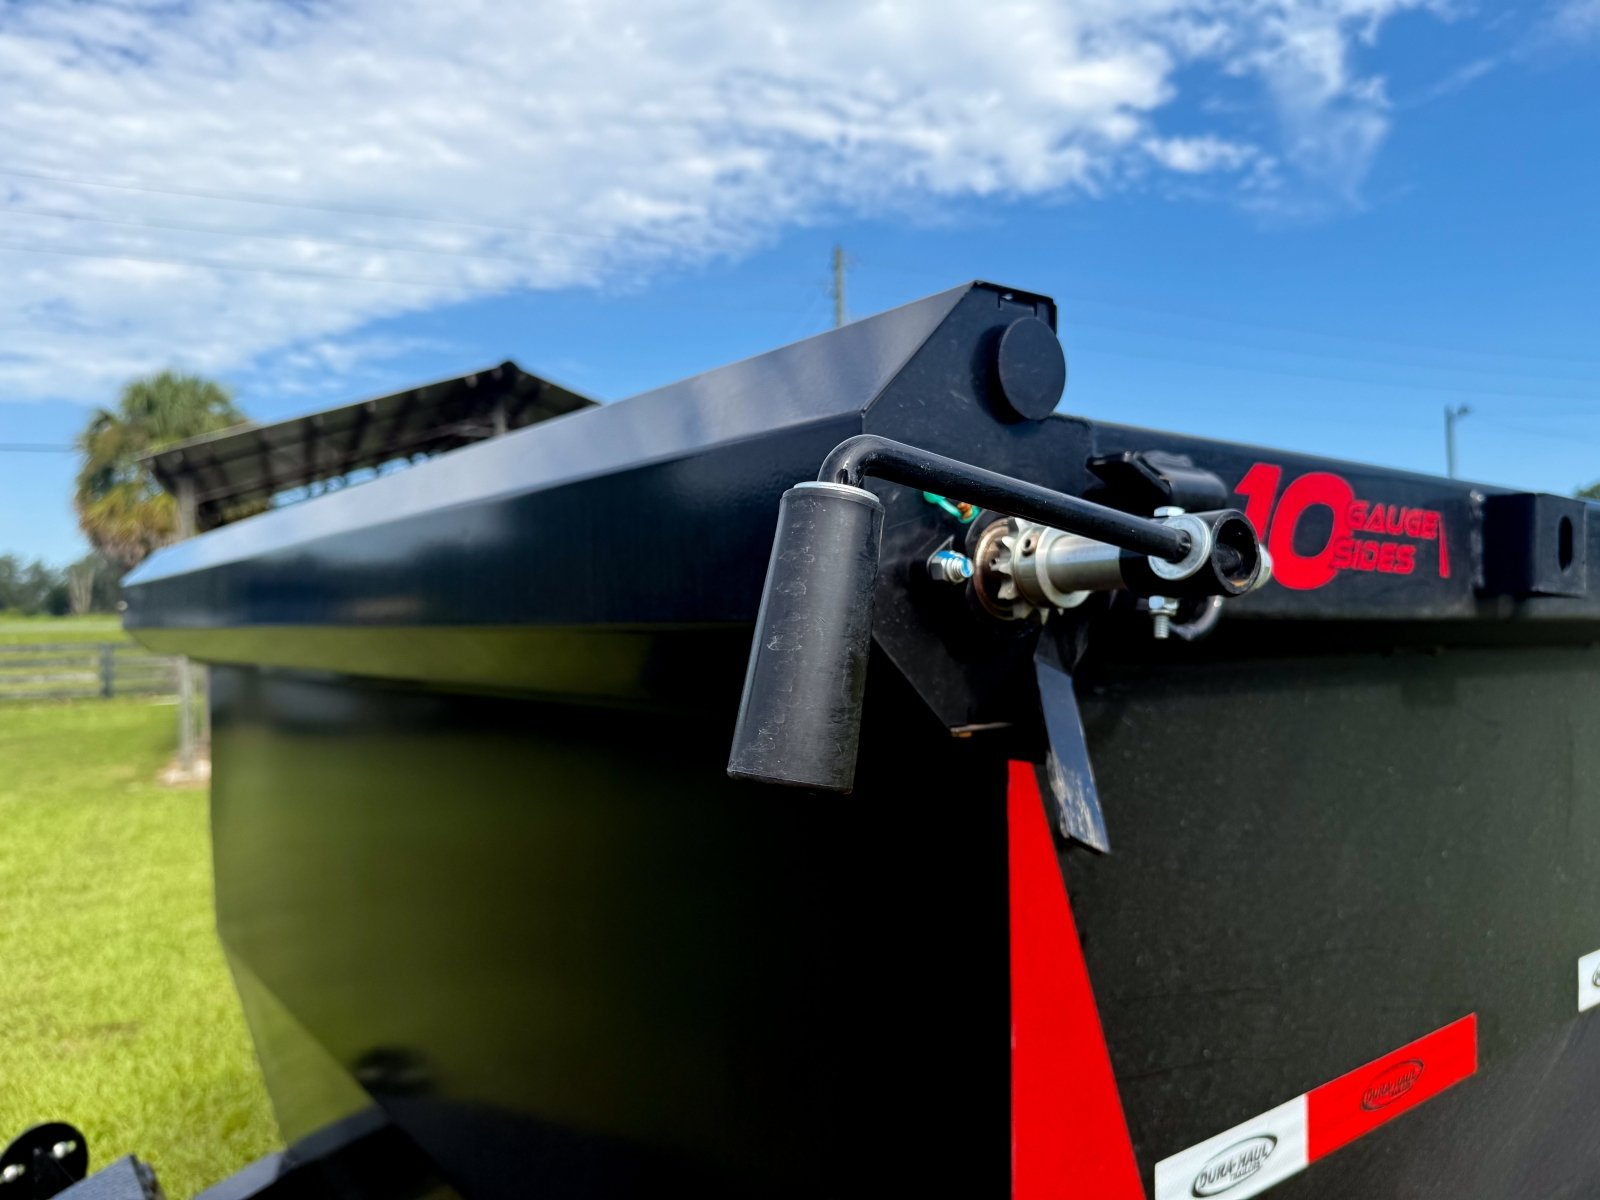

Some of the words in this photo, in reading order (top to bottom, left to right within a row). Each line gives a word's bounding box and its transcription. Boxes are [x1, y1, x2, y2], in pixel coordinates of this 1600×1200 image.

[1235, 462, 1354, 590] 10
[1347, 500, 1440, 540] GAUGE
[1330, 537, 1415, 574] SIDES
[1199, 1143, 1268, 1188] DURA-HAUL
